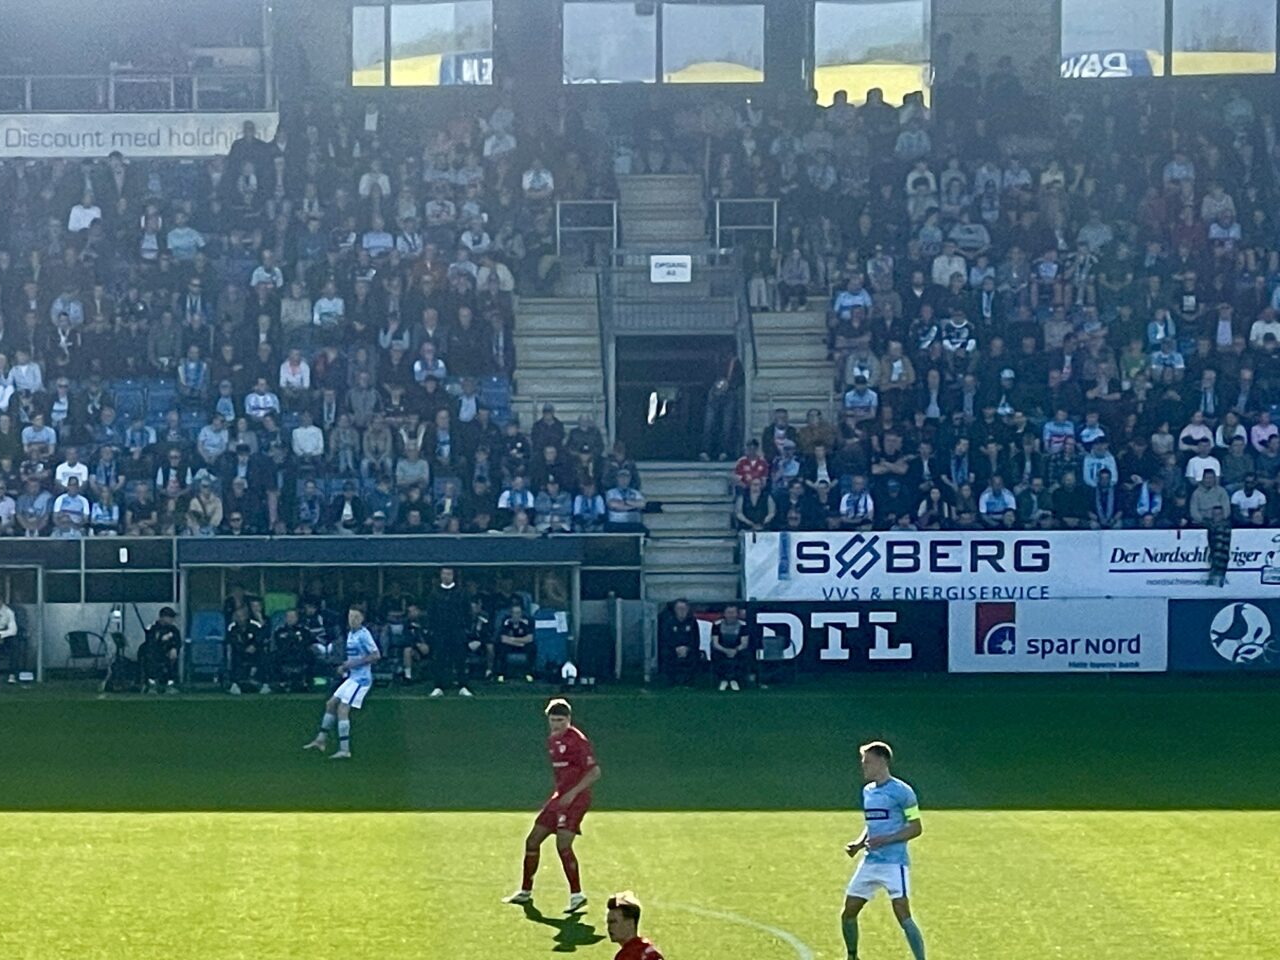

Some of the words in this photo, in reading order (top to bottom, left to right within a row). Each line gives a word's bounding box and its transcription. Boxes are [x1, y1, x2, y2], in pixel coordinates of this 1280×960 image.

[5, 127, 105, 148] Discount
[111, 128, 161, 147] med
[1109, 547, 1140, 564] Der
[822, 586, 861, 600] VVS
[870, 586, 883, 600] &
[892, 585, 1051, 600] ENERGISERVICE
[1026, 638, 1081, 660] spar
[1085, 633, 1141, 655] Nord
